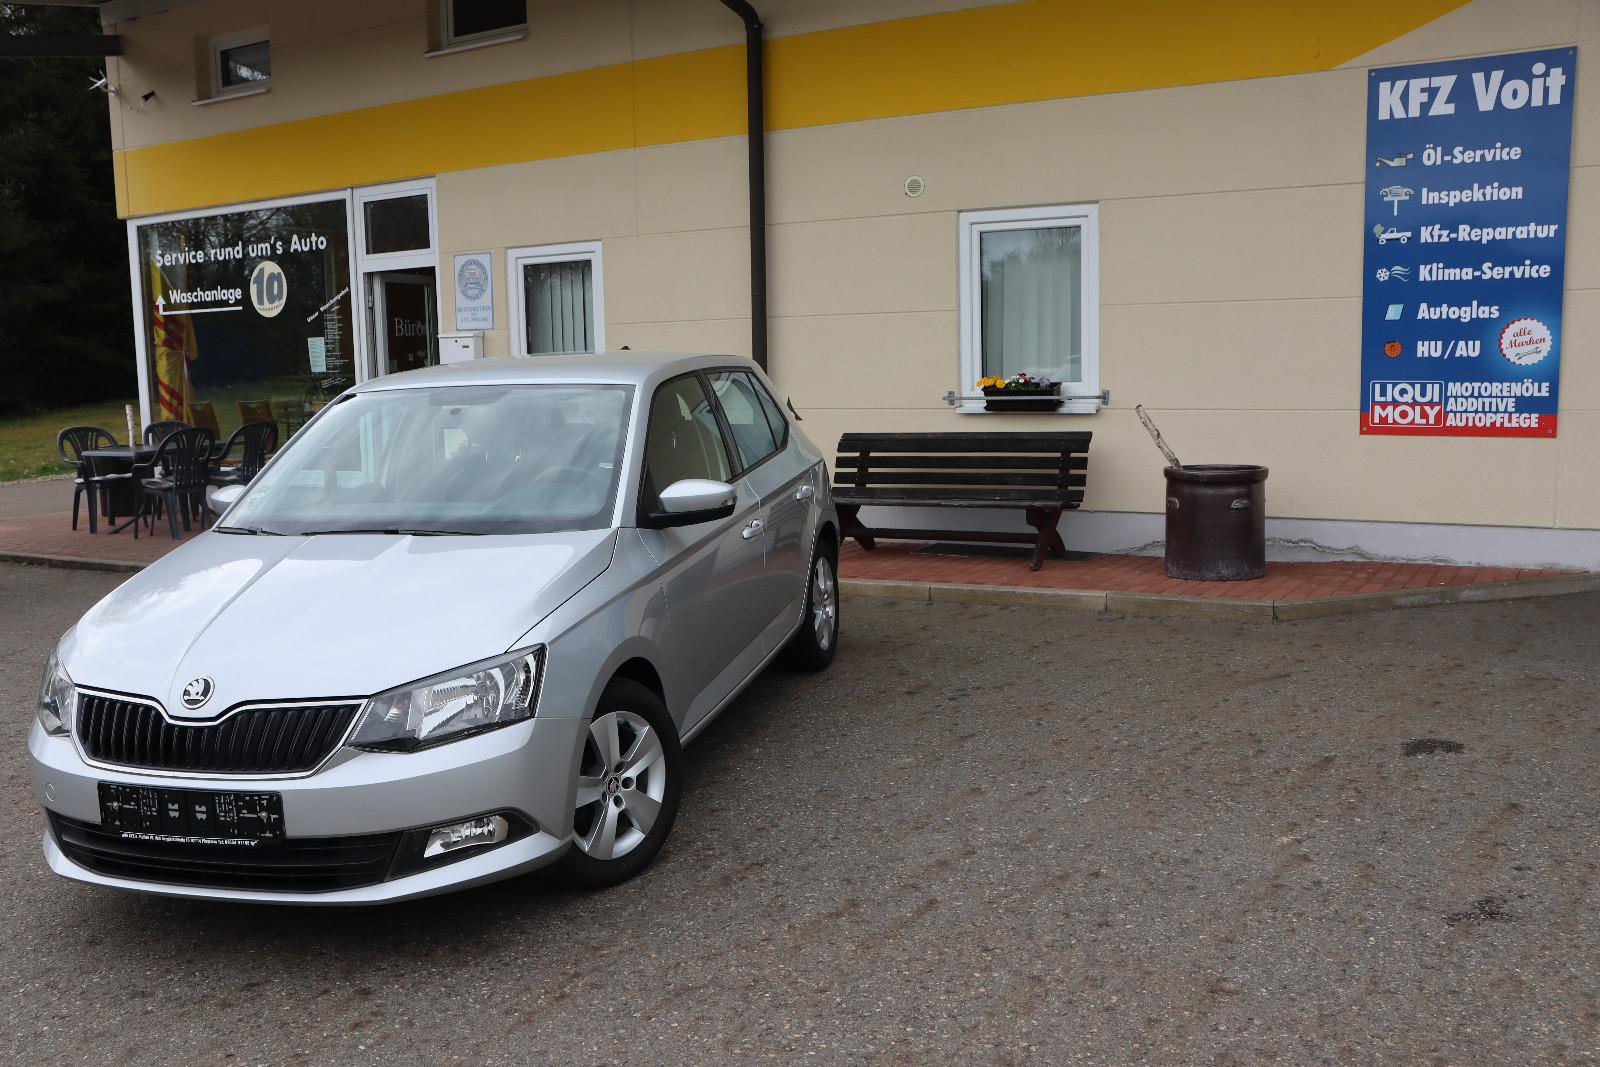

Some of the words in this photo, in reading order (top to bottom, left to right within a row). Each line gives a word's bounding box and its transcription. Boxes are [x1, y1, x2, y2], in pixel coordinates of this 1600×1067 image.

[1378, 74, 1458, 120] KFZ
[1471, 62, 1566, 112] Voit
[1422, 142, 1522, 166] Öl-Service
[1421, 182, 1523, 207] Inspektion
[1420, 222, 1558, 244] Kfz-Reparatur
[155, 247, 204, 267] Service
[210, 241, 243, 261] rund
[248, 236, 283, 257] um's
[290, 232, 327, 252] Auto
[1418, 260, 1551, 282] Klima-Service
[169, 285, 242, 304] Waschanlage
[252, 267, 284, 306] 1a
[1416, 300, 1500, 323] Autoglas
[394, 317, 424, 337] Büro
[1512, 327, 1532, 338] alle
[1506, 335, 1547, 350] Marken
[1374, 383, 1440, 404] LIQUI
[1446, 379, 1550, 397] MOTORENÖLE
[1373, 405, 1442, 425] MOLY
[1446, 397, 1516, 412] ADDITIVE
[1446, 413, 1539, 428] AUTOPFLEGE
